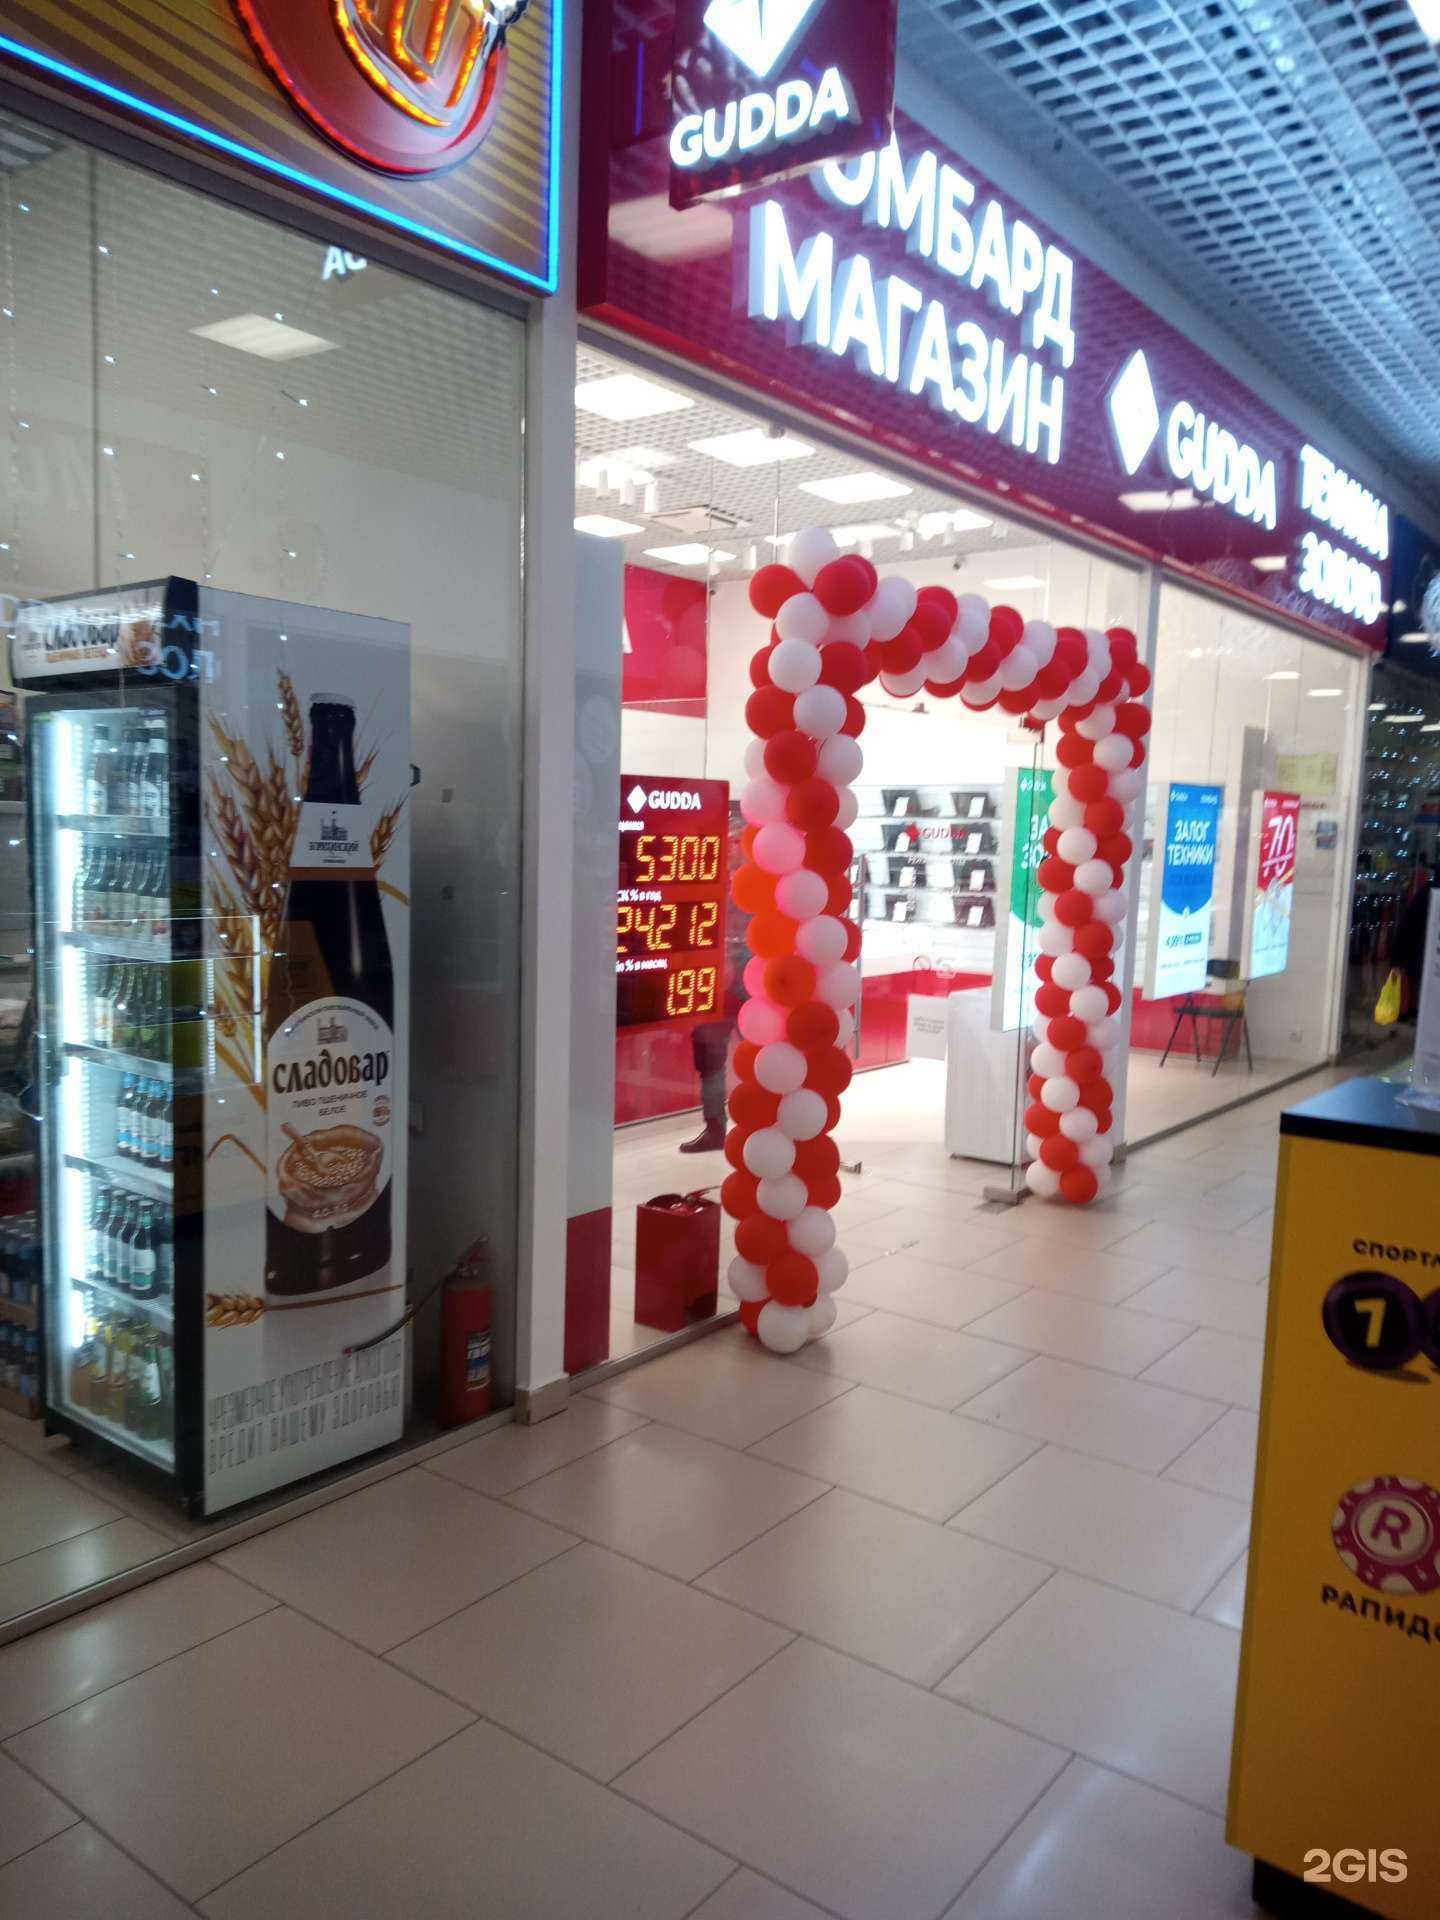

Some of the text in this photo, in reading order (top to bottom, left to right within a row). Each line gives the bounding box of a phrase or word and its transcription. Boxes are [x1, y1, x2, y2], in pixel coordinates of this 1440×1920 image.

[669, 66, 849, 168] GUDDA
[756, 199, 1065, 465] МАГАЗИН
[1166, 400, 1277, 531] GUDDA
[648, 790, 702, 811] GUDDA
[1167, 842, 1216, 867] ТЕХНИКИ
[1173, 819, 1212, 843] ЗАЛОГ
[635, 835, 720, 882] 5300
[1353, 1298, 1387, 1349] 7
[1370, 1505, 1413, 1551] R
